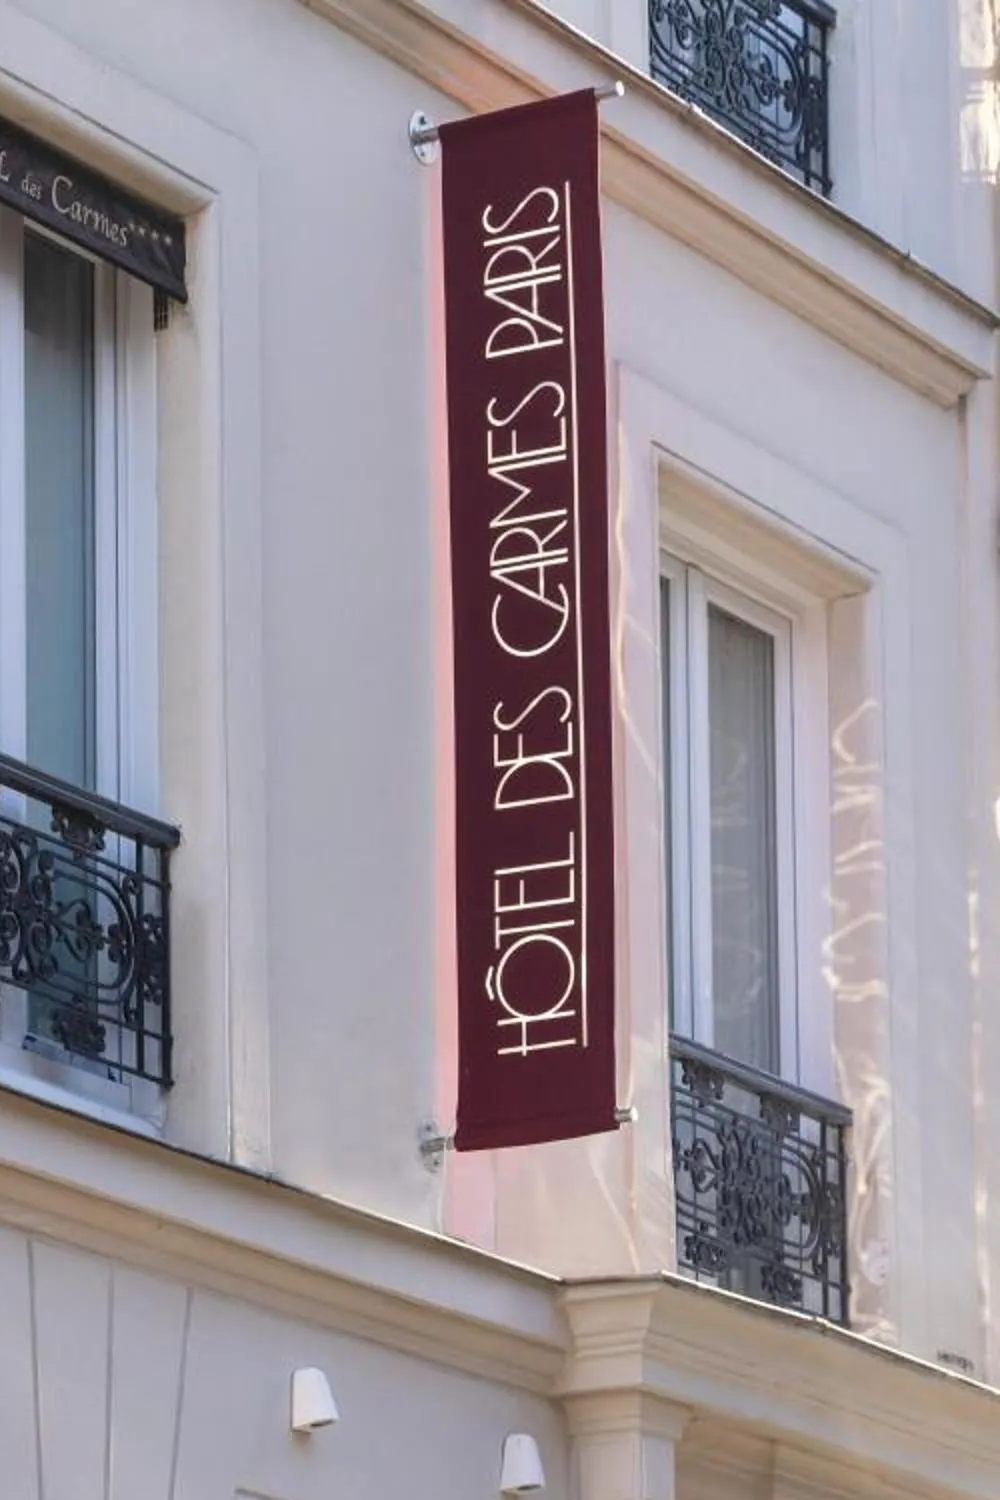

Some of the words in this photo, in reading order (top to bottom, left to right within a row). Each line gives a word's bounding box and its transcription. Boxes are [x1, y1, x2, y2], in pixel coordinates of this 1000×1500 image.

[51, 175, 129, 247] Carmes
[482, 187, 564, 359] PARIS
[486, 381, 569, 658] CARMES
[493, 685, 575, 810] DES
[485, 830, 577, 1057] HÔTEL
